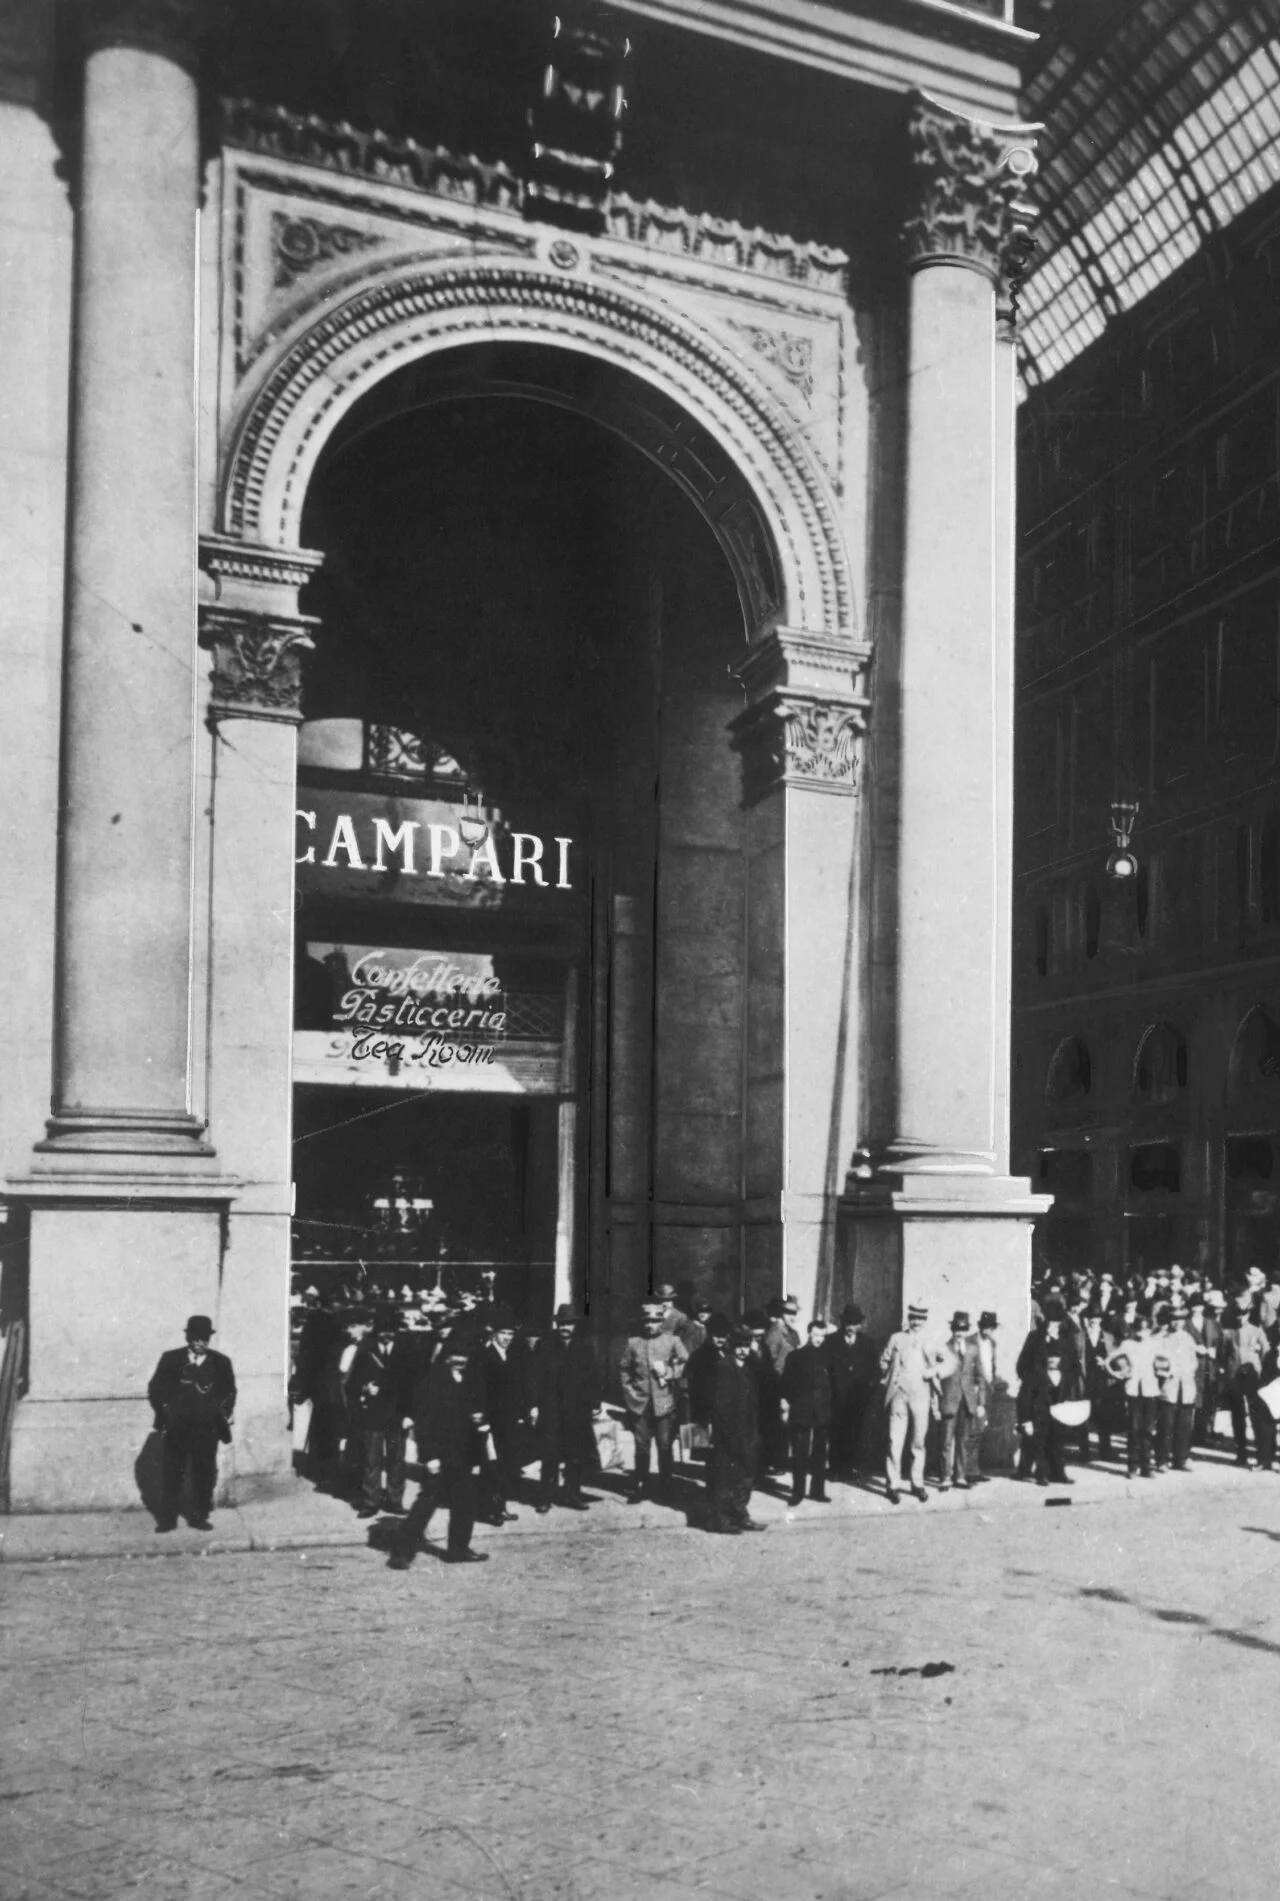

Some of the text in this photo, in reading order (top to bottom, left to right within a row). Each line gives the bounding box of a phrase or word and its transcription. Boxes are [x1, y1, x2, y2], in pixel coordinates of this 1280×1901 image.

[295, 809, 573, 889] CAMPARI
[352, 950, 502, 997] Confetteria
[332, 988, 507, 1032] Pasticceria
[352, 1025, 496, 1069] Tea Room
